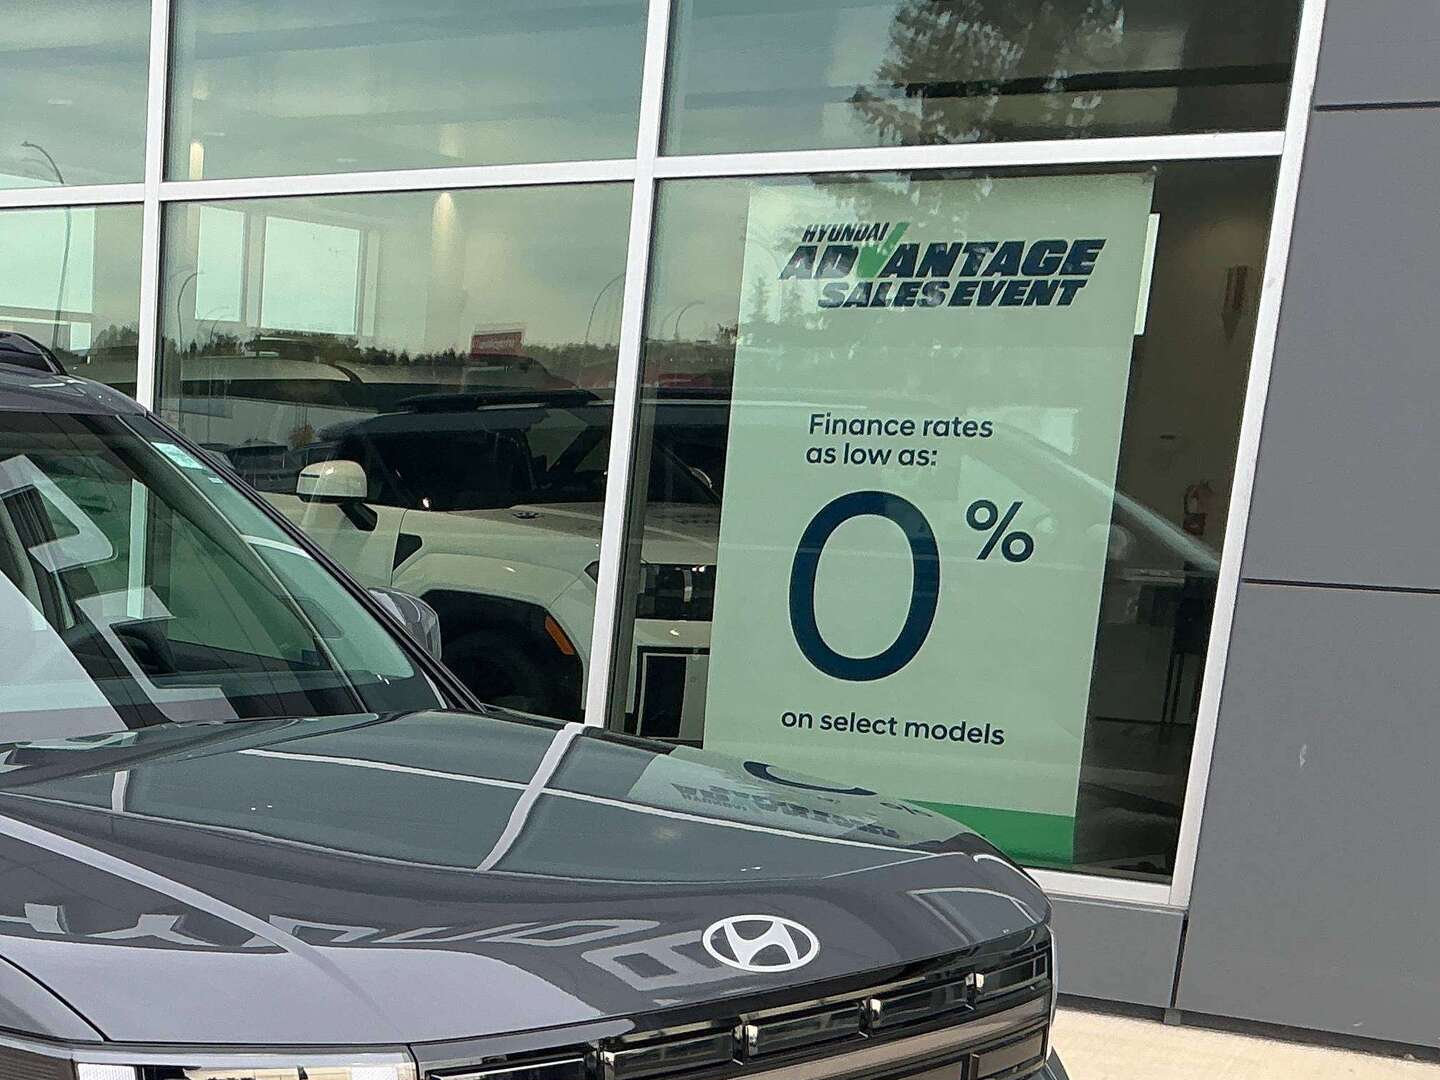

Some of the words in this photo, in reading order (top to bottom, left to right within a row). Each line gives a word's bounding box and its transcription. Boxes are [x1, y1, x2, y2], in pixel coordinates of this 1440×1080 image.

[802, 222, 890, 243] HYUNDAI
[778, 222, 1107, 281] ADVANTAGE
[817, 280, 950, 309] SALES
[947, 278, 1088, 308] EVENT
[809, 411, 916, 437] Finance
[922, 416, 994, 438] rates
[806, 446, 837, 464] as
[843, 442, 892, 465] low
[898, 448, 938, 466] as:
[781, 711, 813, 729] on
[819, 712, 898, 736] select
[904, 721, 1006, 746] models
